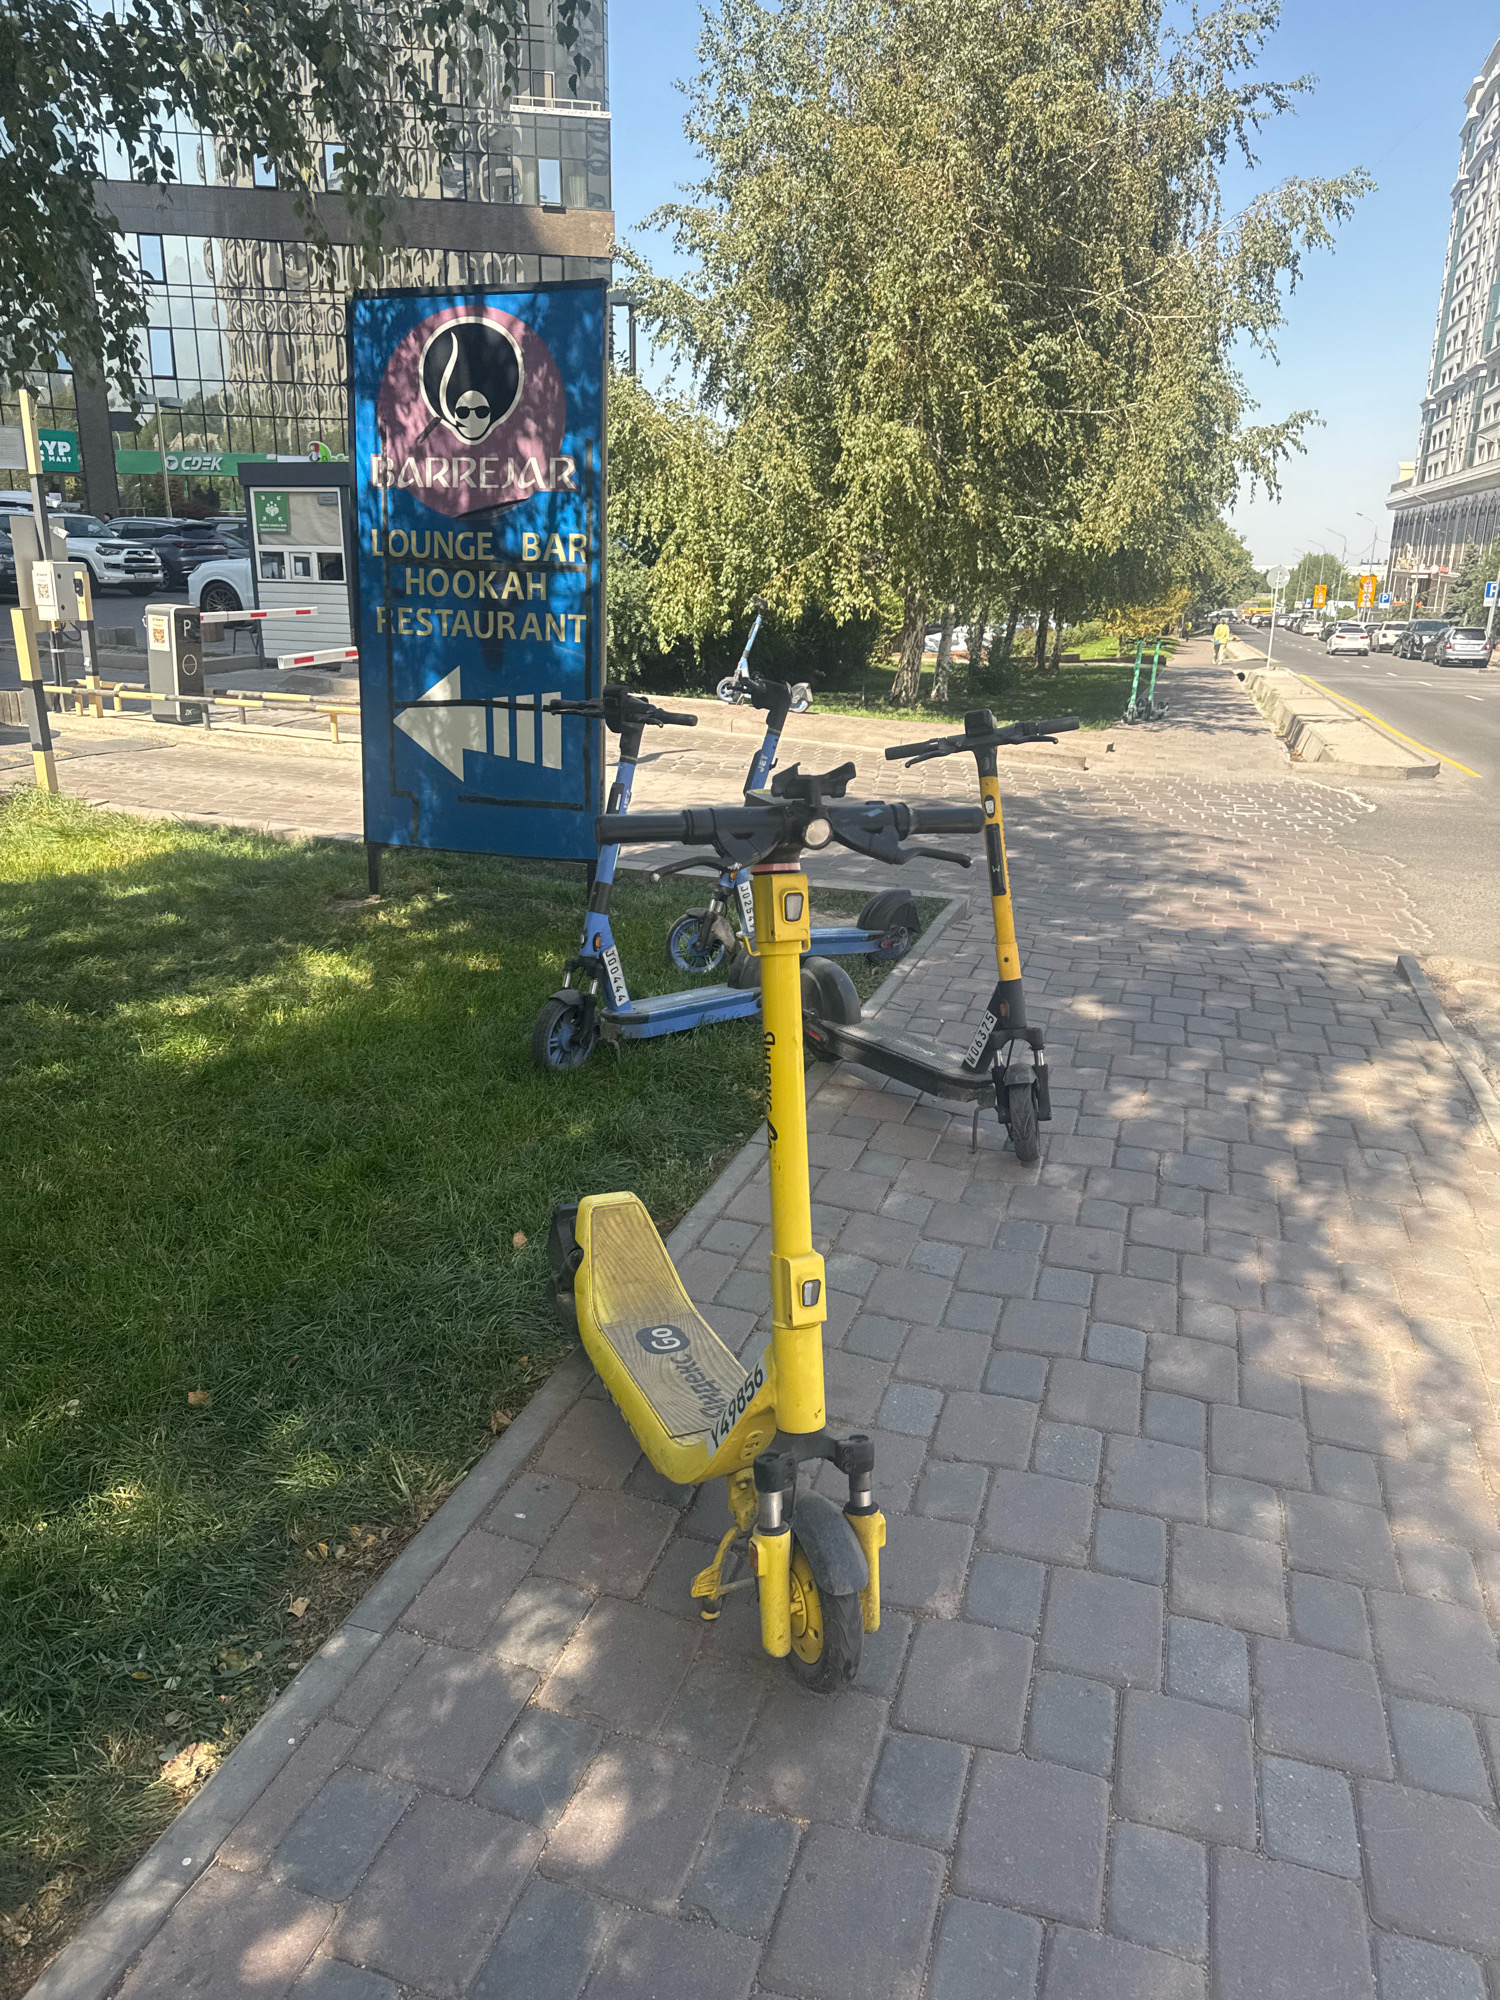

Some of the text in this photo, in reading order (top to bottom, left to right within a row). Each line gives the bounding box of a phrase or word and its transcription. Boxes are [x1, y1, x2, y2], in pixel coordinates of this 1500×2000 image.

[39, 440, 71, 456] YP
[48, 455, 72, 463] MART
[181, 456, 223, 471] CDEK
[372, 454, 578, 490] BARREJAR
[371, 529, 587, 563] LOUNGE BAR
[405, 568, 547, 601] HOOKAH
[183, 619, 191, 637] P
[376, 606, 587, 643] RESTAURANT
[758, 754, 768, 773] JET
[605, 949, 626, 1002] J00444
[651, 1326, 681, 1350] Go
[710, 1361, 764, 1449] Y49856
